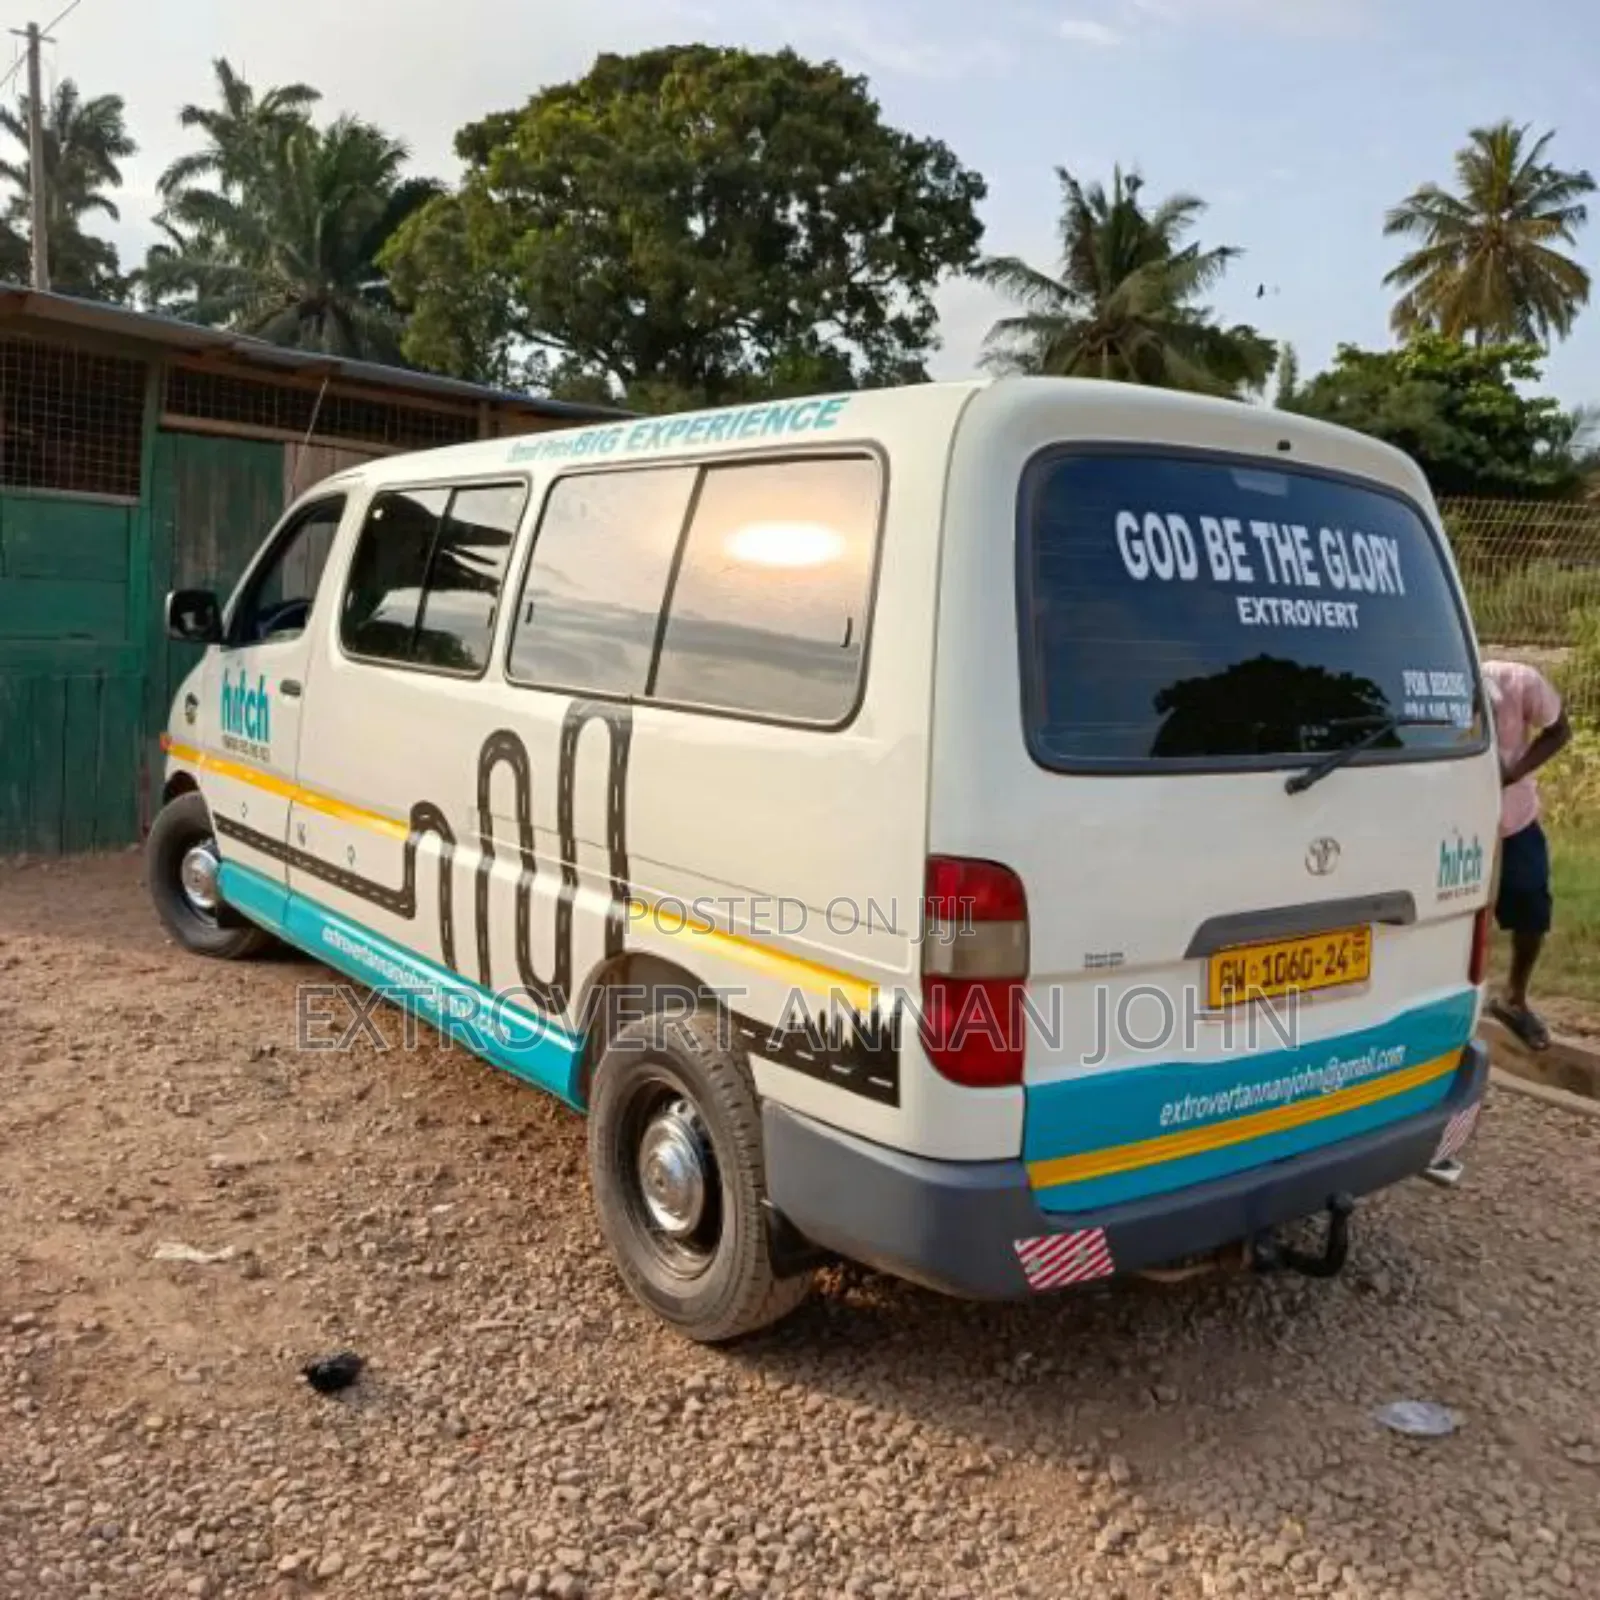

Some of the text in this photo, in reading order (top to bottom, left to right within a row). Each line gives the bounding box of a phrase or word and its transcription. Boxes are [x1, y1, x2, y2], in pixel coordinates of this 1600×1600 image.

[573, 427, 619, 454] BIG
[624, 397, 851, 452] EXPERIENCE
[1115, 510, 1405, 596] GOD BE THE GLORY
[1236, 596, 1359, 629] EXTROVERT
[1261, 937, 1350, 988] 1060-24
